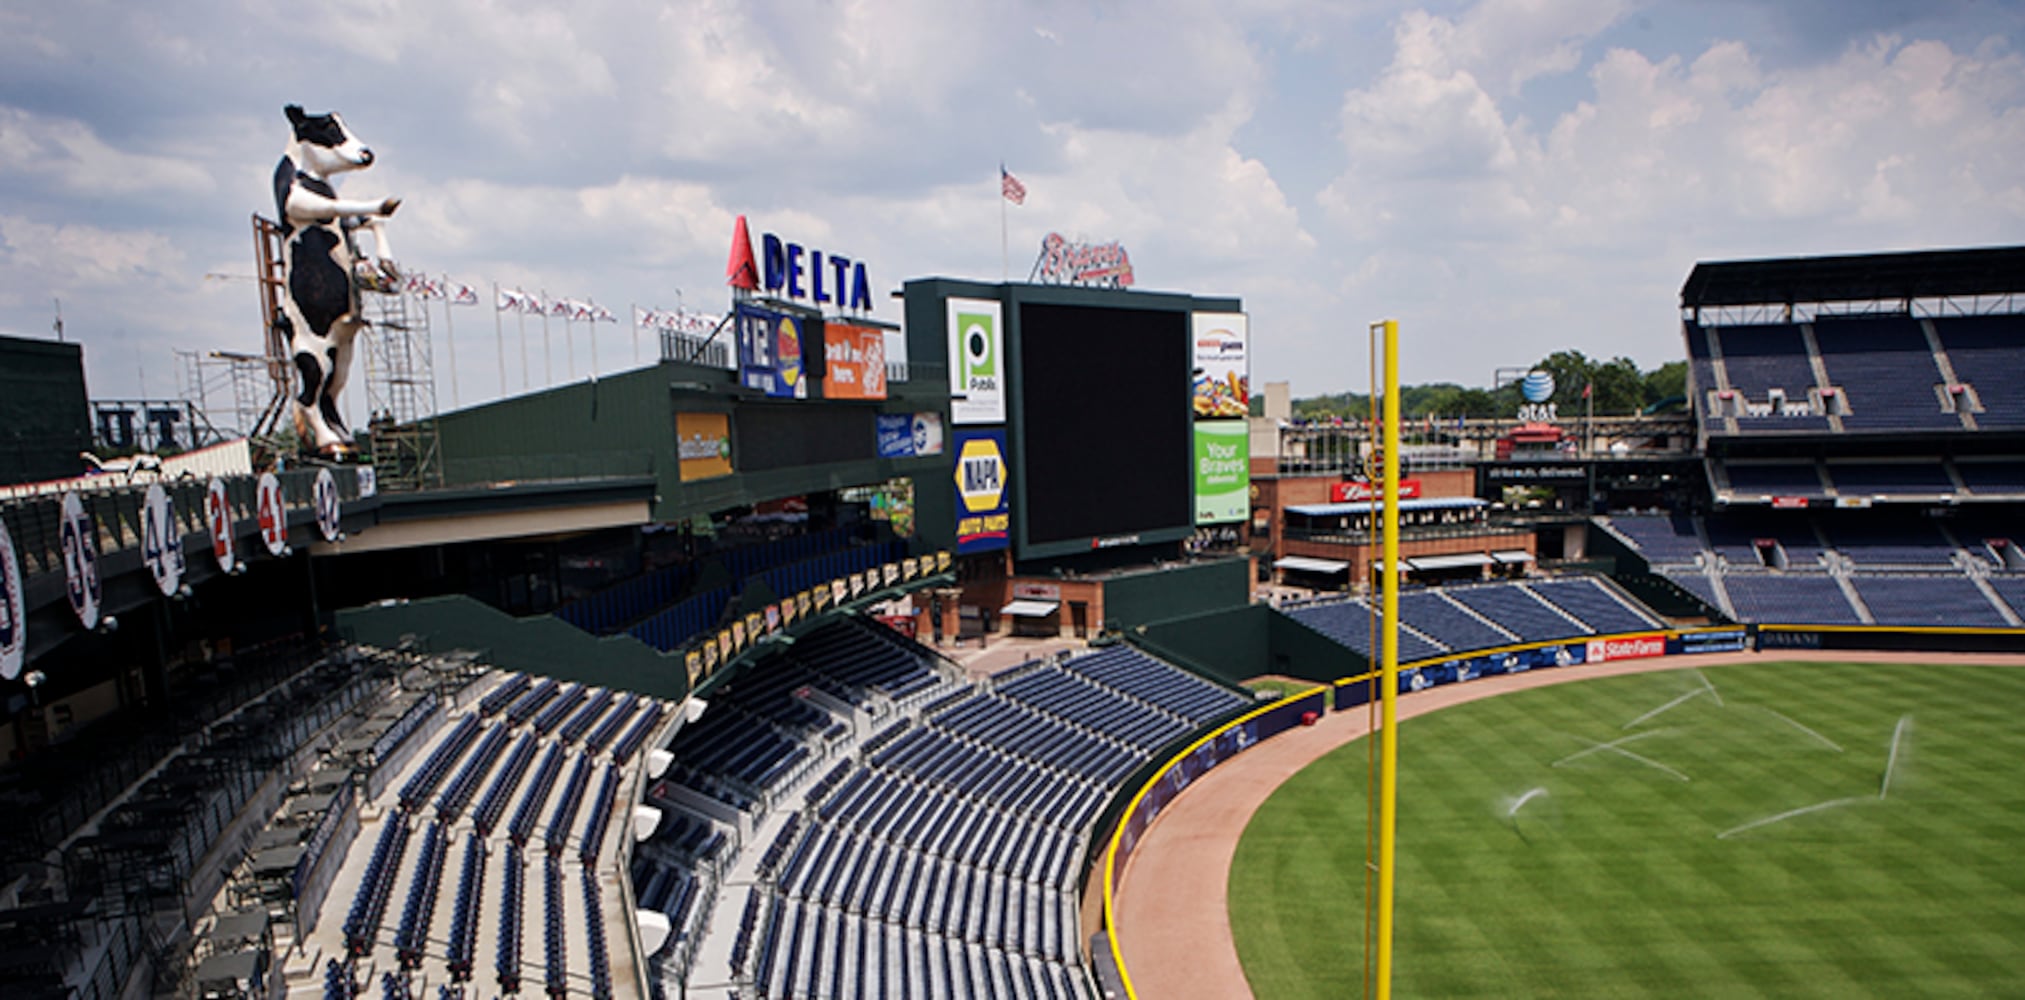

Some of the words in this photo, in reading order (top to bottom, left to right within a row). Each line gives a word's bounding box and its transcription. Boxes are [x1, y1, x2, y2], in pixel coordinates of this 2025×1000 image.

[762, 233, 873, 310] DELTA
[1200, 457, 1246, 475] Braves
[1207, 442, 1238, 459] Your
[964, 458, 999, 491] NAPA
[259, 486, 288, 544] 41
